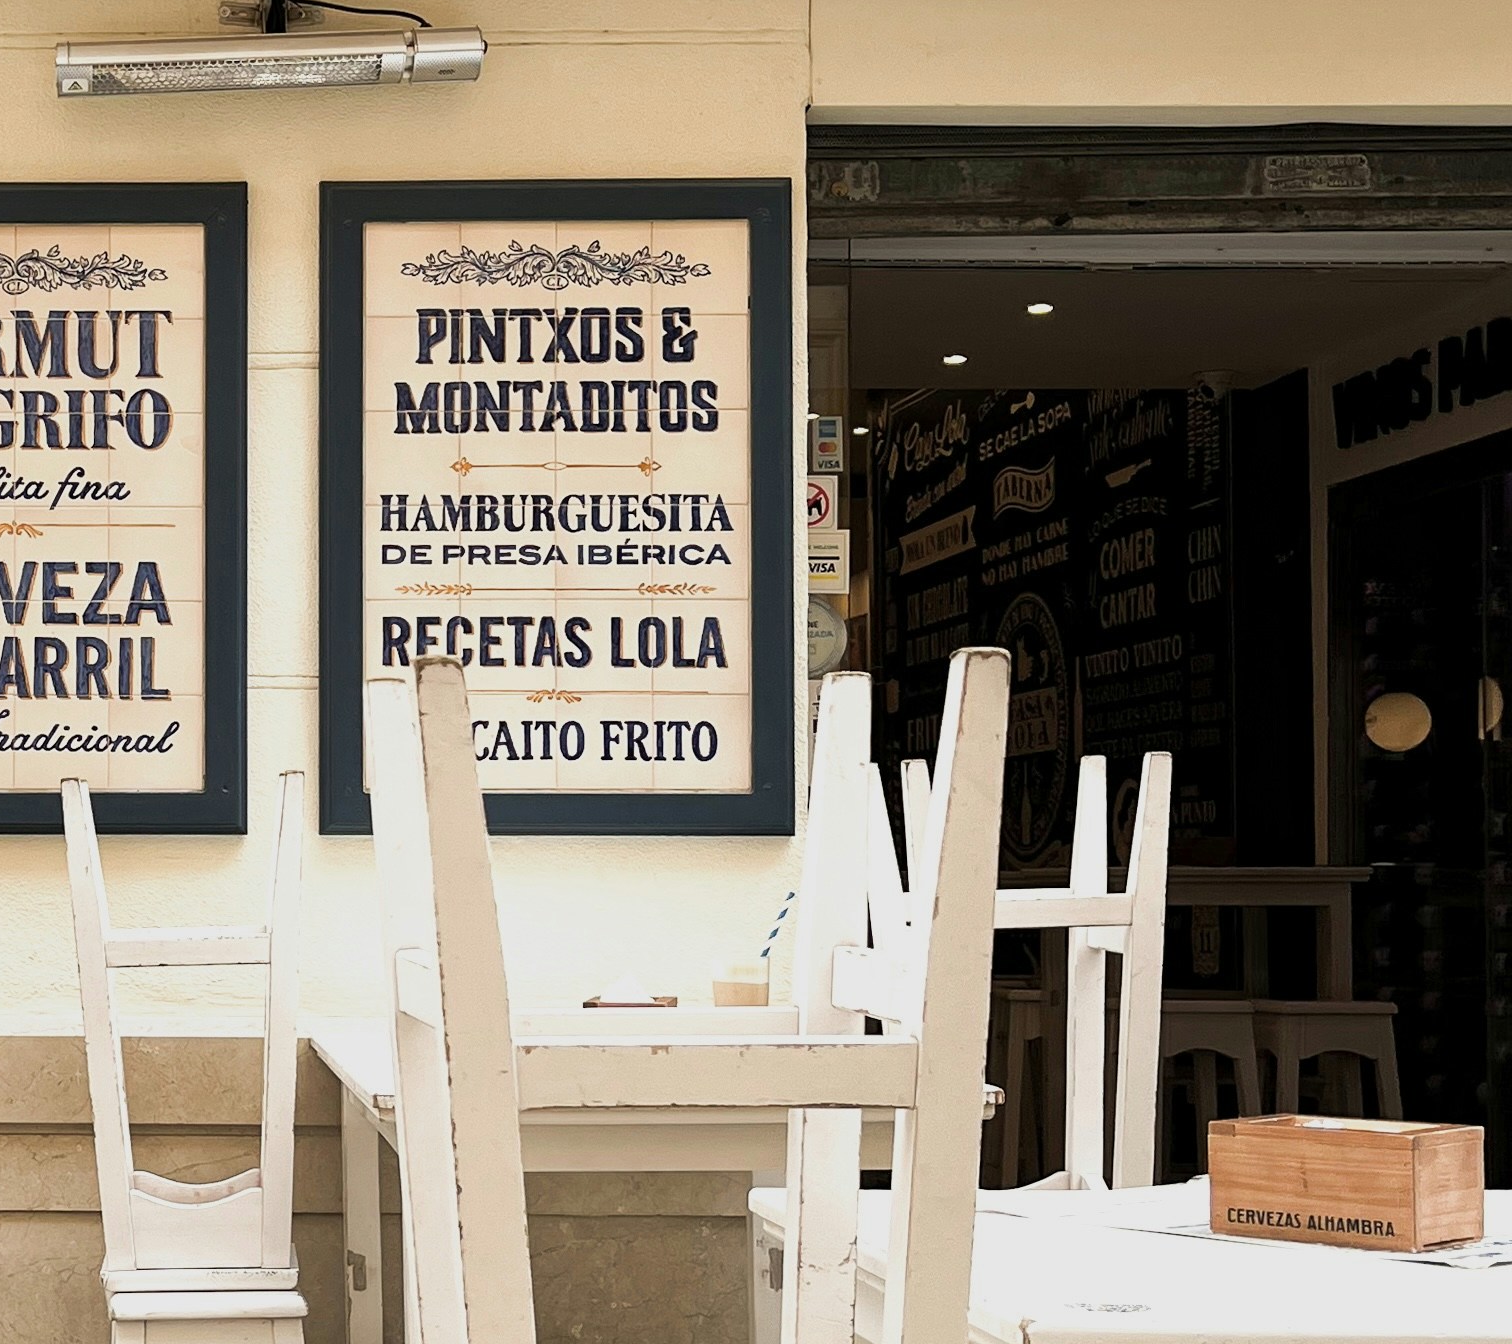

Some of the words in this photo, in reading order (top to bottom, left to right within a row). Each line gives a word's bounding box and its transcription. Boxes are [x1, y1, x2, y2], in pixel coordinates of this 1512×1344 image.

[415, 307, 645, 366] PINTXOS
[662, 305, 699, 362] &
[394, 379, 720, 435] MONTADITOS
[995, 425, 1019, 453] CAE
[1020, 418, 1037, 441] LA
[1037, 401, 1072, 434] SOPA
[817, 460, 841, 470] VISA
[50, 467, 131, 511] fina
[994, 471, 1052, 507] TABERNA
[379, 492, 735, 534] HAMBURGUESITA
[381, 544, 434, 566] DE
[442, 543, 568, 566] PRESA
[577, 537, 733, 566] IBÉRICA
[809, 562, 836, 573] VISA
[1100, 527, 1156, 580] COMER
[1100, 582, 1157, 629] CANTAR
[381, 616, 592, 669] RECETAS
[610, 616, 729, 669] LOLA
[1085, 646, 1129, 678] VINITO
[1133, 634, 1183, 670] VINITO
[473, 720, 587, 762] CAITO
[600, 720, 719, 762] FRITO
[1227, 1208, 1302, 1229] CERVEZAS
[1306, 1214, 1396, 1237] ALHAMBRA
